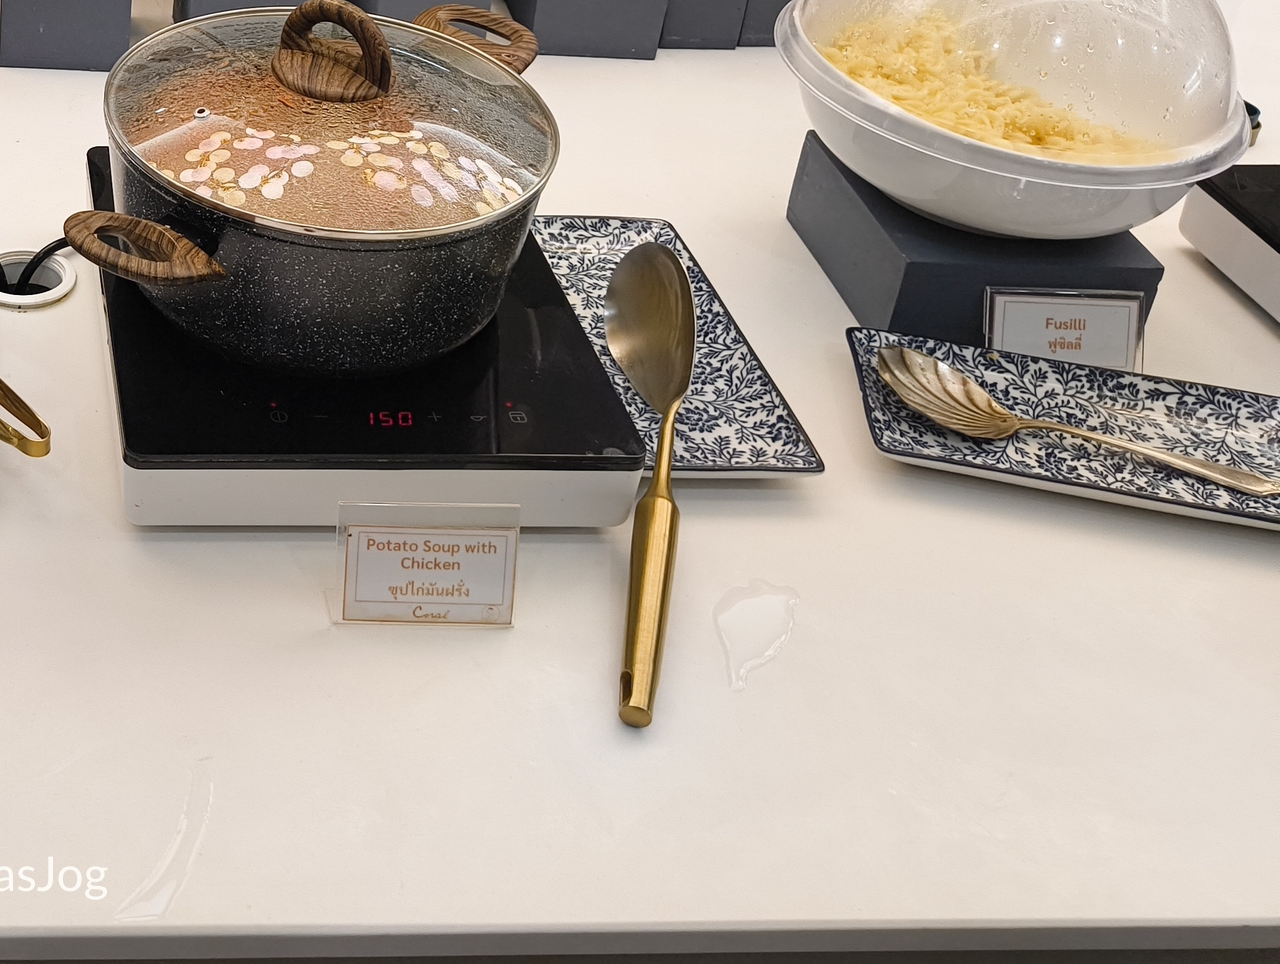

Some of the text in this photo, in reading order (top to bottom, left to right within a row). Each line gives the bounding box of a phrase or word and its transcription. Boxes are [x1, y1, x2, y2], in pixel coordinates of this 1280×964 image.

[1045, 317, 1086, 331] Fusilli
[369, 411, 413, 426] 150
[366, 538, 497, 557] Potato Soup with
[401, 557, 461, 571] Chicken
[388, 579, 470, 601] ซุปไก่มันฝรั่ง
[412, 605, 450, 619] Coral
